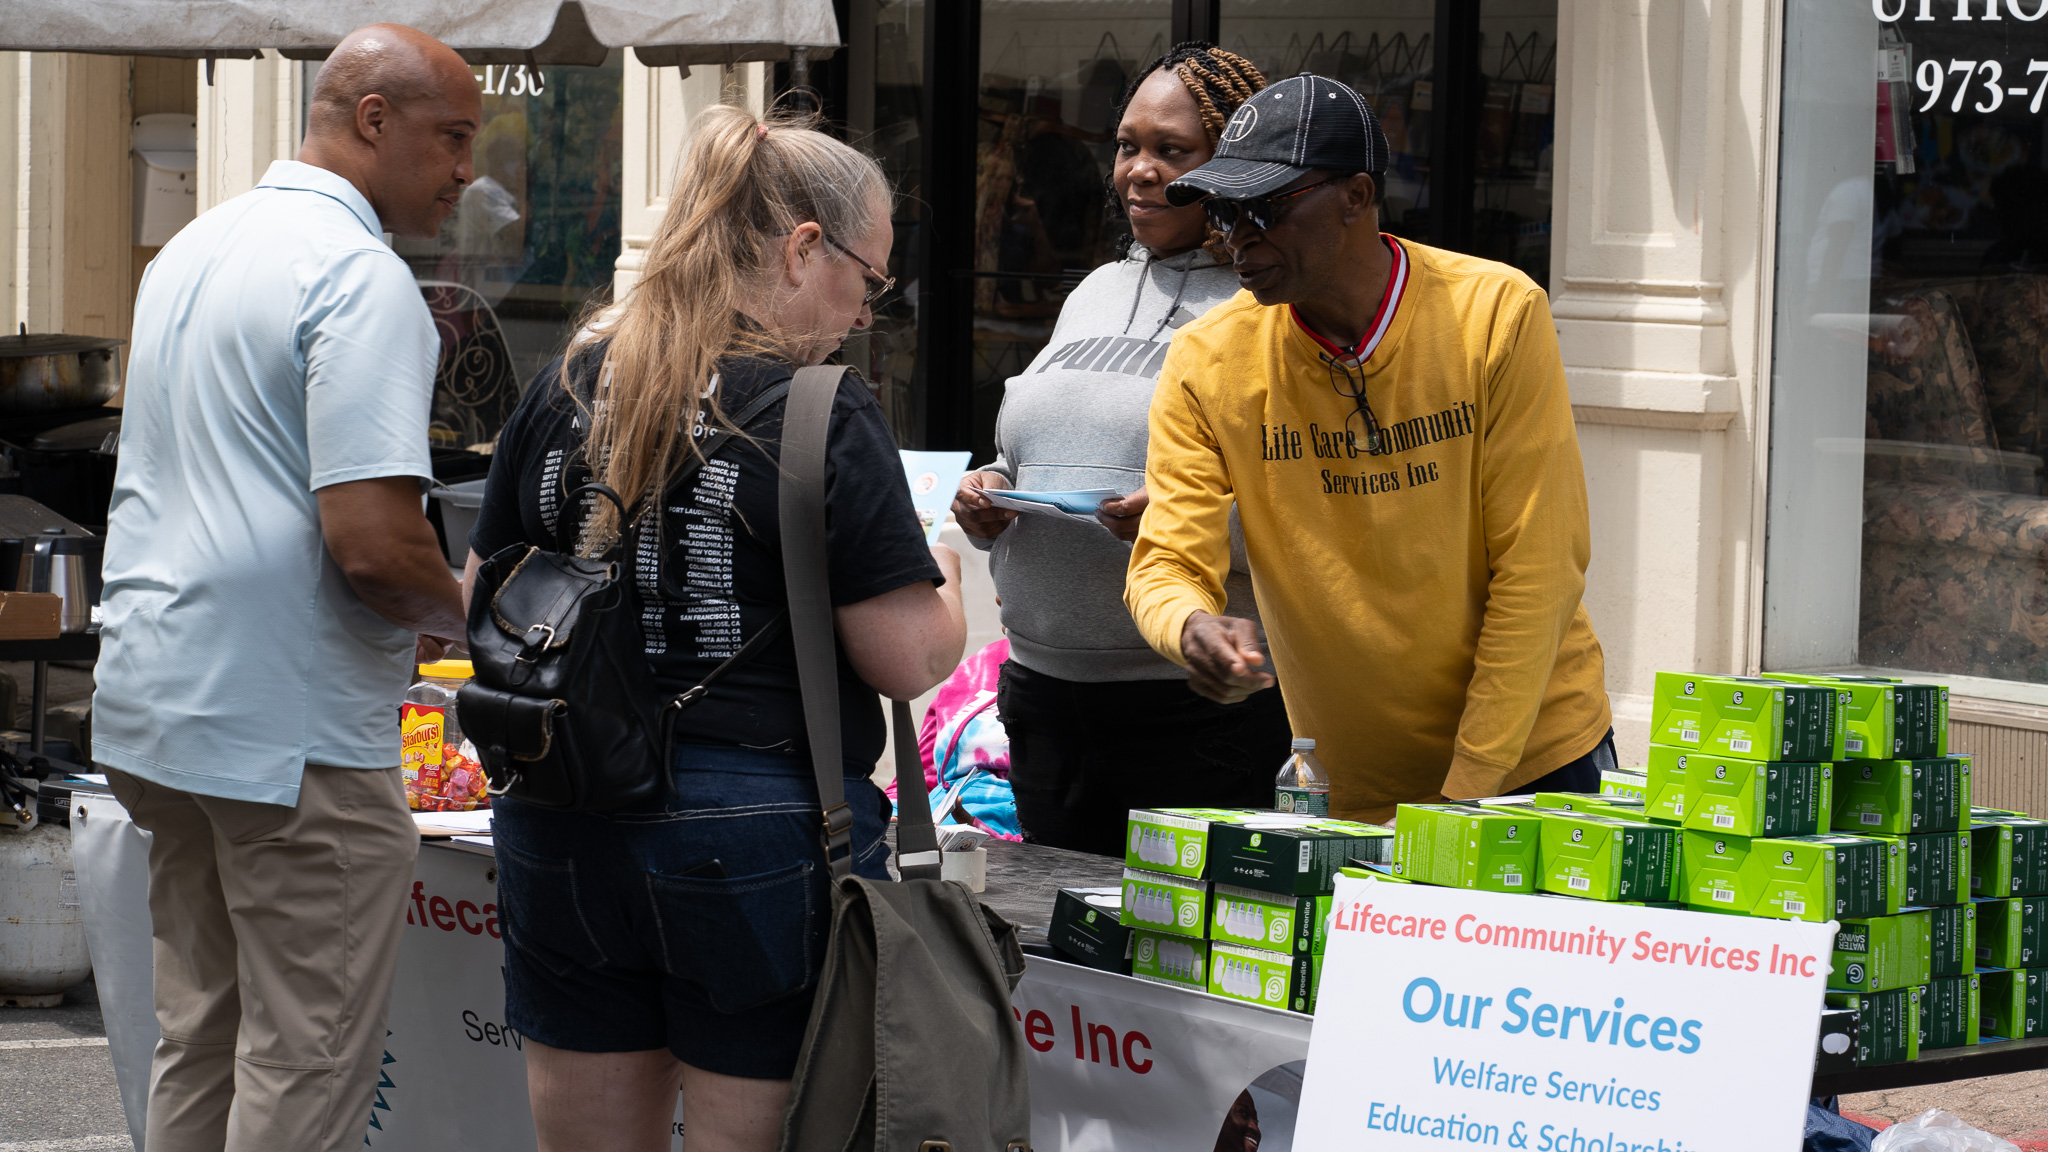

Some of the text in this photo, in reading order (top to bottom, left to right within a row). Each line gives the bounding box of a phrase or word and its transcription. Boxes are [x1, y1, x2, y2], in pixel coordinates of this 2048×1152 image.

[1261, 424, 1302, 461] Life
[1309, 423, 1357, 459] Care
[710, 459, 730, 468] SMITH,
[706, 474, 725, 484] LOUIS,
[726, 477, 736, 485] MO
[1321, 461, 1439, 495] Services Inc
[700, 481, 728, 491] CHICAGO,
[695, 495, 722, 507] ATLANTA,
[686, 524, 724, 534] CHARLOTTE,
[689, 532, 723, 542] RICHMOND,
[679, 540, 723, 549] PHILADELPHIA,
[685, 555, 722, 564] PITTSBURGH,
[689, 564, 722, 572] COLUMBUS,
[686, 571, 722, 580] CINCINNATI,
[687, 579, 723, 588] LOUISVILLE,
[402, 723, 439, 748] Starburst
[1397, 832, 1405, 862] greenlite
[1664, 833, 1672, 887] HIGH-EFFICIENCY
[1303, 900, 1311, 937] greenlite
[1853, 926, 1866, 934] KIT
[1335, 901, 1817, 977] Lifecare Community Services Inc
[1838, 933, 1865, 943] SAVING
[1838, 942, 1865, 951] WATER
[1402, 976, 1703, 1054] Our Services
[1071, 1004, 1153, 1075] Inc
[1433, 1056, 1661, 1111] Welfare Services
[1367, 1102, 1499, 1146] Education
[1507, 1121, 1528, 1150] &
